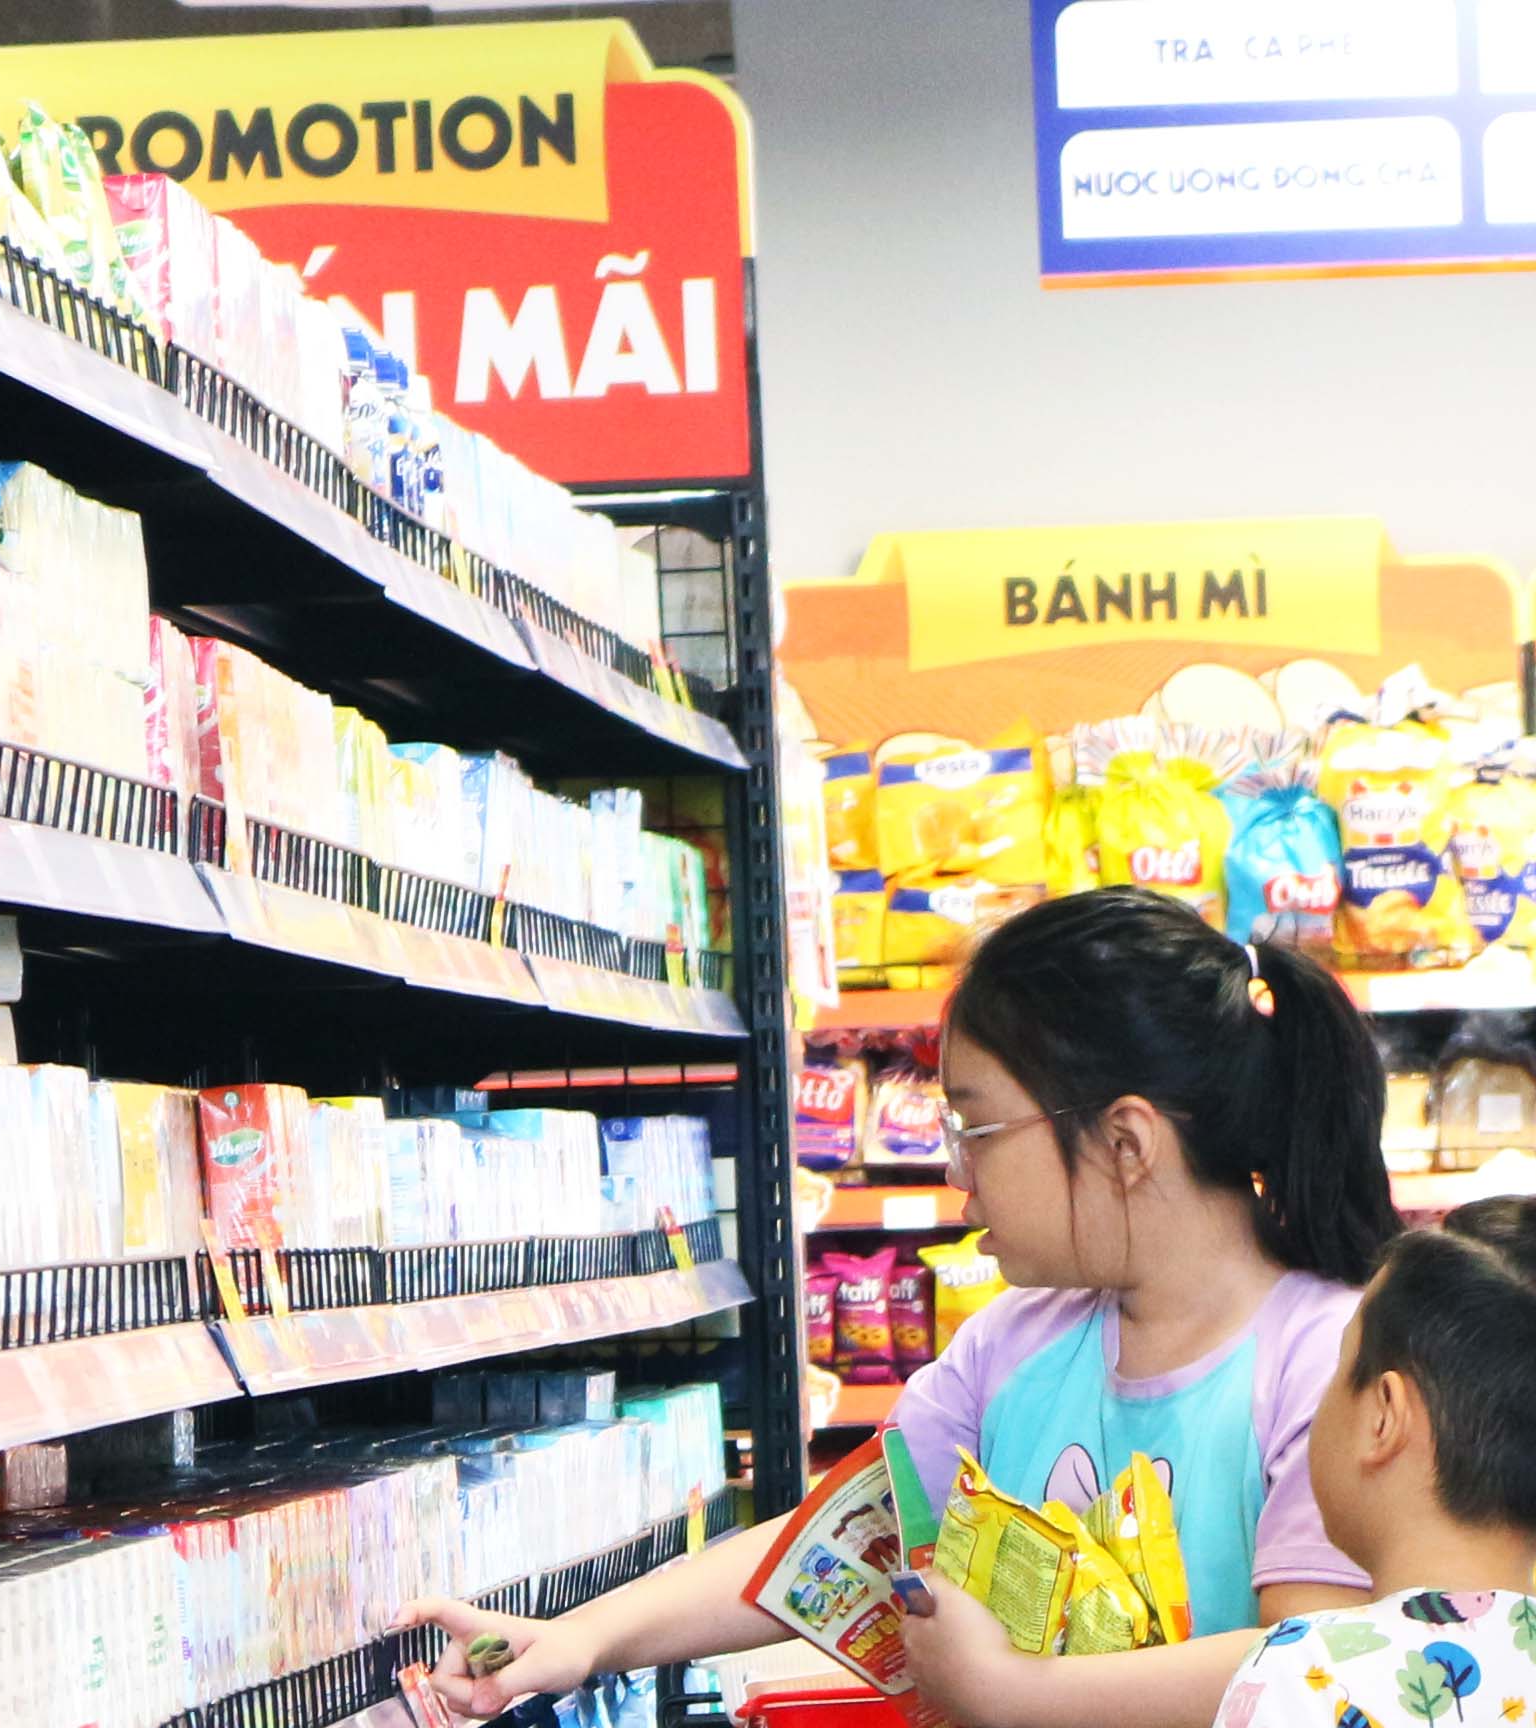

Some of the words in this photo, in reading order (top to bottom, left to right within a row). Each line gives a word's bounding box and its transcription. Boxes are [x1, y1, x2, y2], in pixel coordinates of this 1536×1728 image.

[76, 91, 577, 184] ROMOTION
[455, 251, 718, 404] MÃI
[1004, 558, 1177, 628] BÁNH
[1193, 550, 1269, 621] MÌ
[1348, 803, 1417, 823] Harrys
